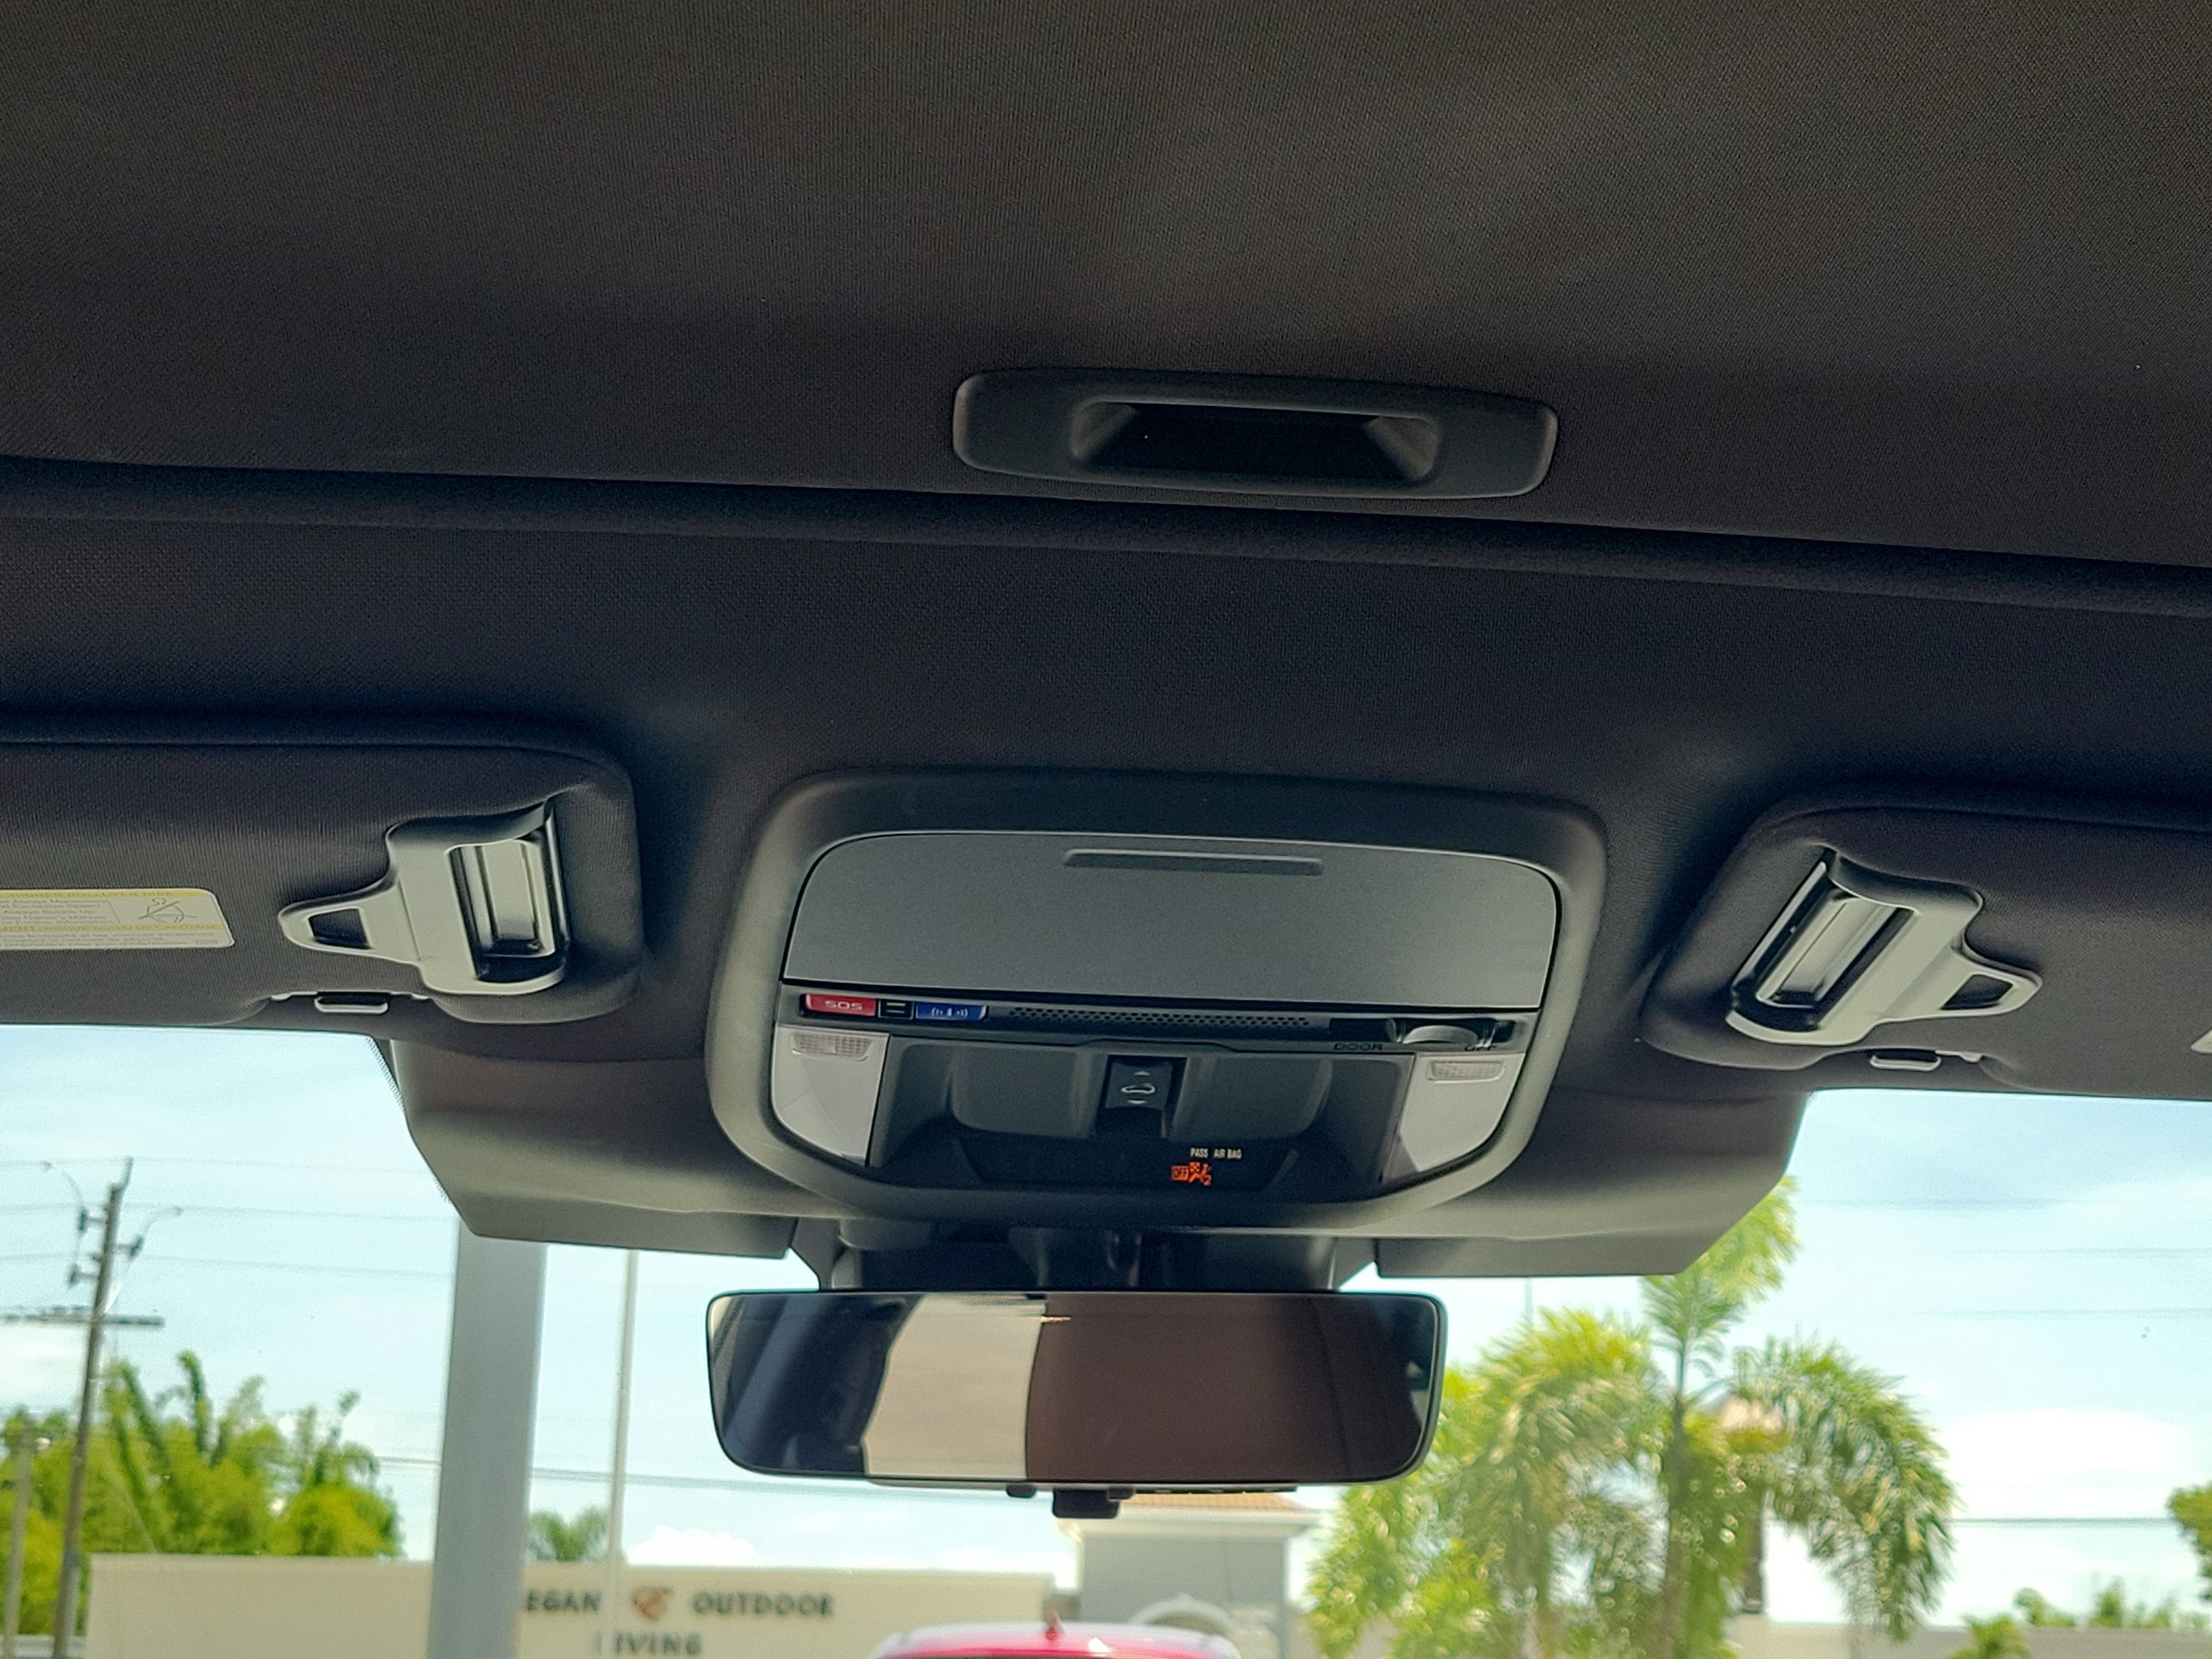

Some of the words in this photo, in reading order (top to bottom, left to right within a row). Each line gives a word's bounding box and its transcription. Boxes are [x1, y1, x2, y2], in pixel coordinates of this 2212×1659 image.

[825, 1000, 863, 1010] SOS
[1190, 1147, 1209, 1158] PASS
[692, 1592, 834, 1616] OUTDOOR
